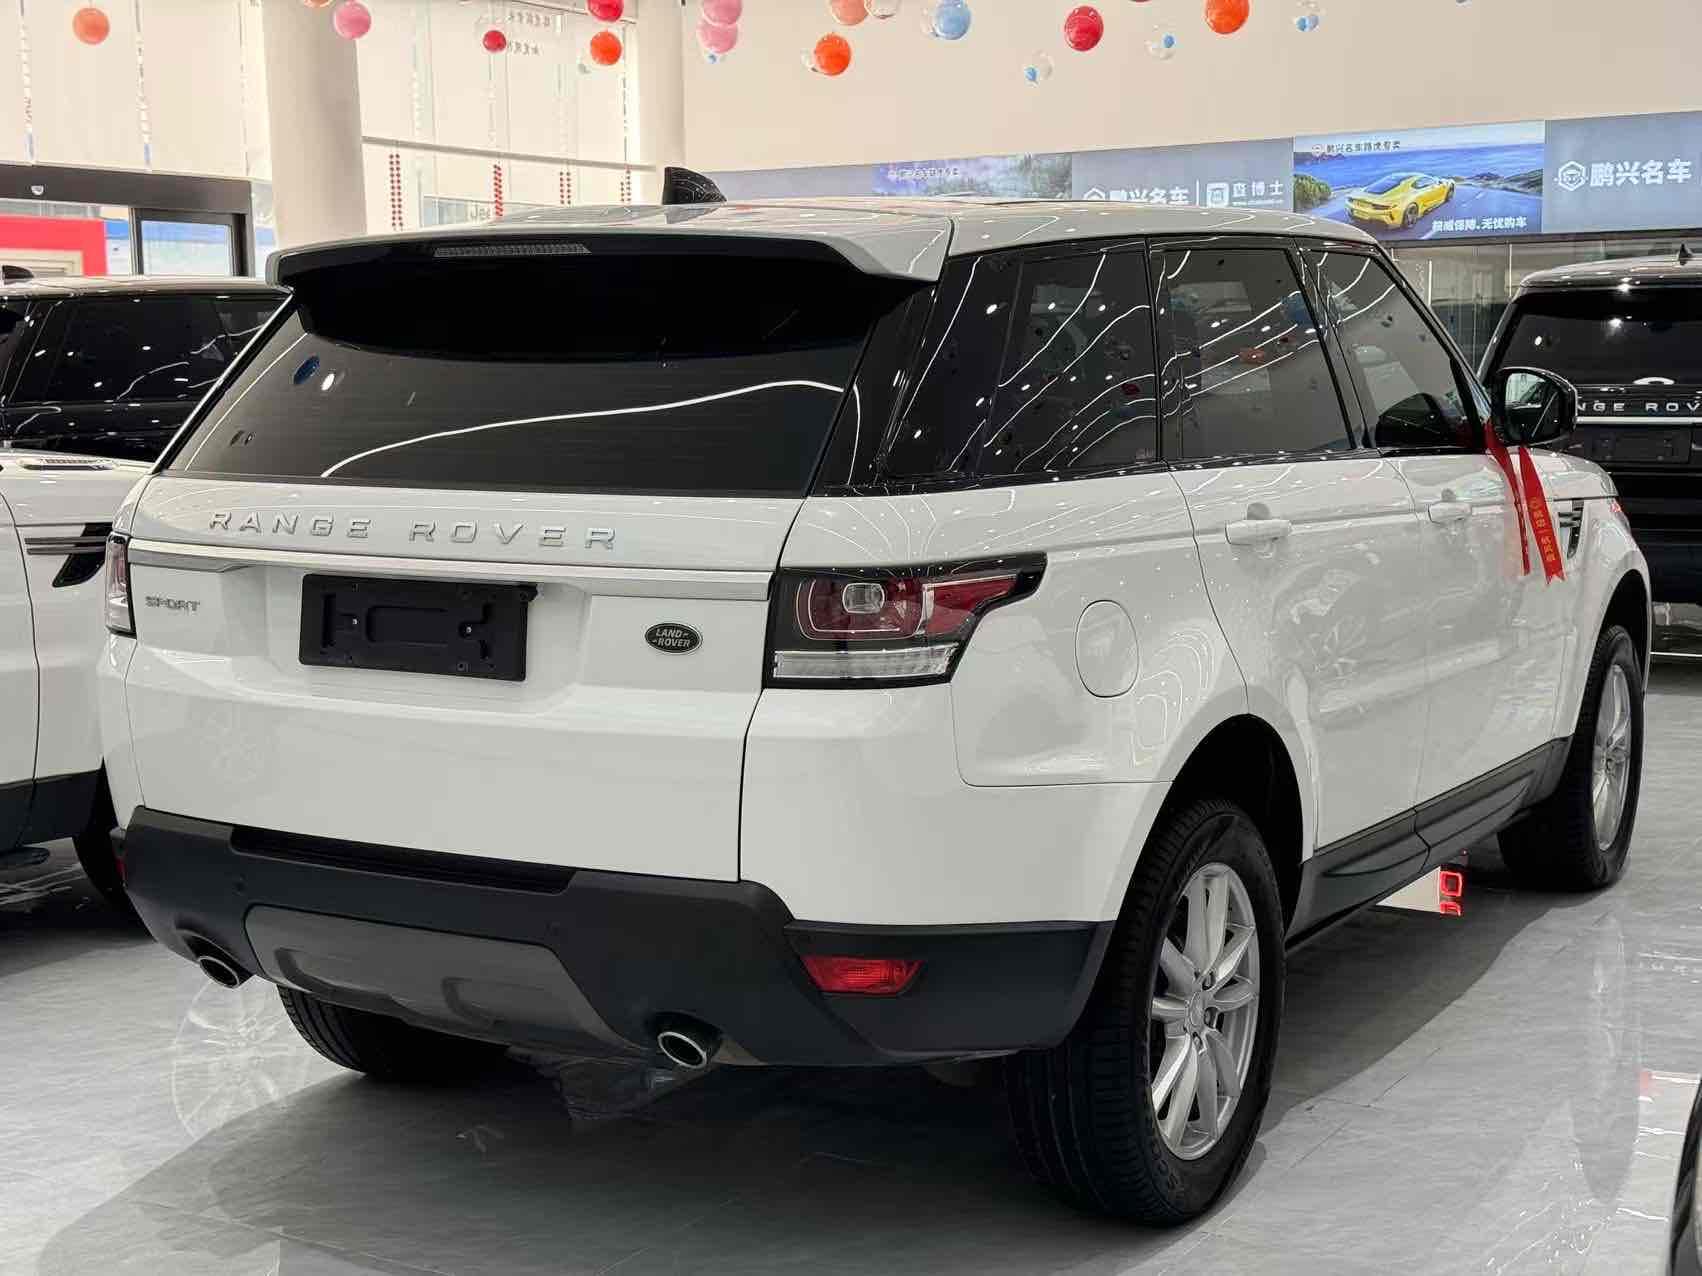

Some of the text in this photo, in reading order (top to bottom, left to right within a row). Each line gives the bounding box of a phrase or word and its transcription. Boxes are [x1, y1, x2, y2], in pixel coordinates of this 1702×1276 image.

[1589, 158, 1692, 187] 鹏兴名车
[1577, 402, 1701, 412] NGE ROV
[208, 511, 617, 550] RANGE ROVER
[145, 595, 201, 611] SPORT
